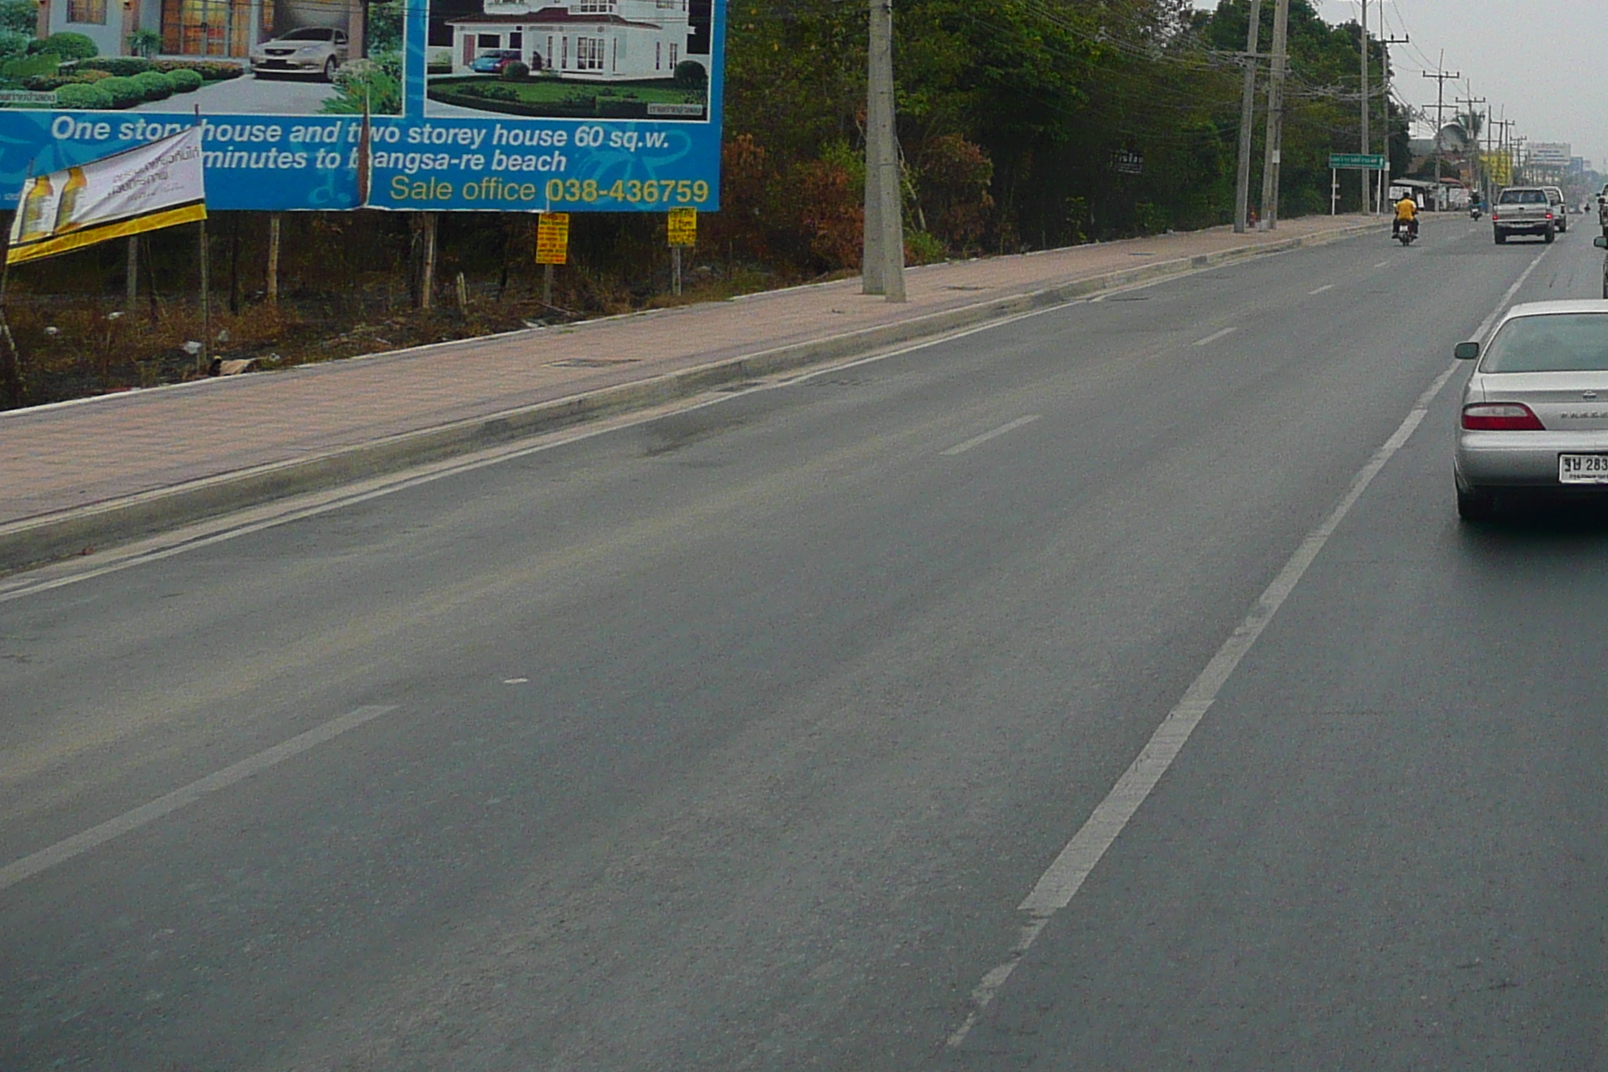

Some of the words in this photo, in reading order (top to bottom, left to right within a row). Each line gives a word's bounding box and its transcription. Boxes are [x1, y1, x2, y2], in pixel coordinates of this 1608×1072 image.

[51, 115, 110, 140] One
[200, 119, 281, 142] house
[289, 120, 342, 143] and
[407, 123, 485, 149] storey
[492, 124, 567, 147] house
[574, 126, 603, 147] 60
[609, 130, 669, 151] sq.w.
[201, 145, 308, 168] minutes
[316, 148, 341, 168] to
[491, 151, 567, 172] beach
[390, 176, 453, 201] Sale
[462, 177, 536, 202] office
[545, 178, 709, 203] 038-436759
